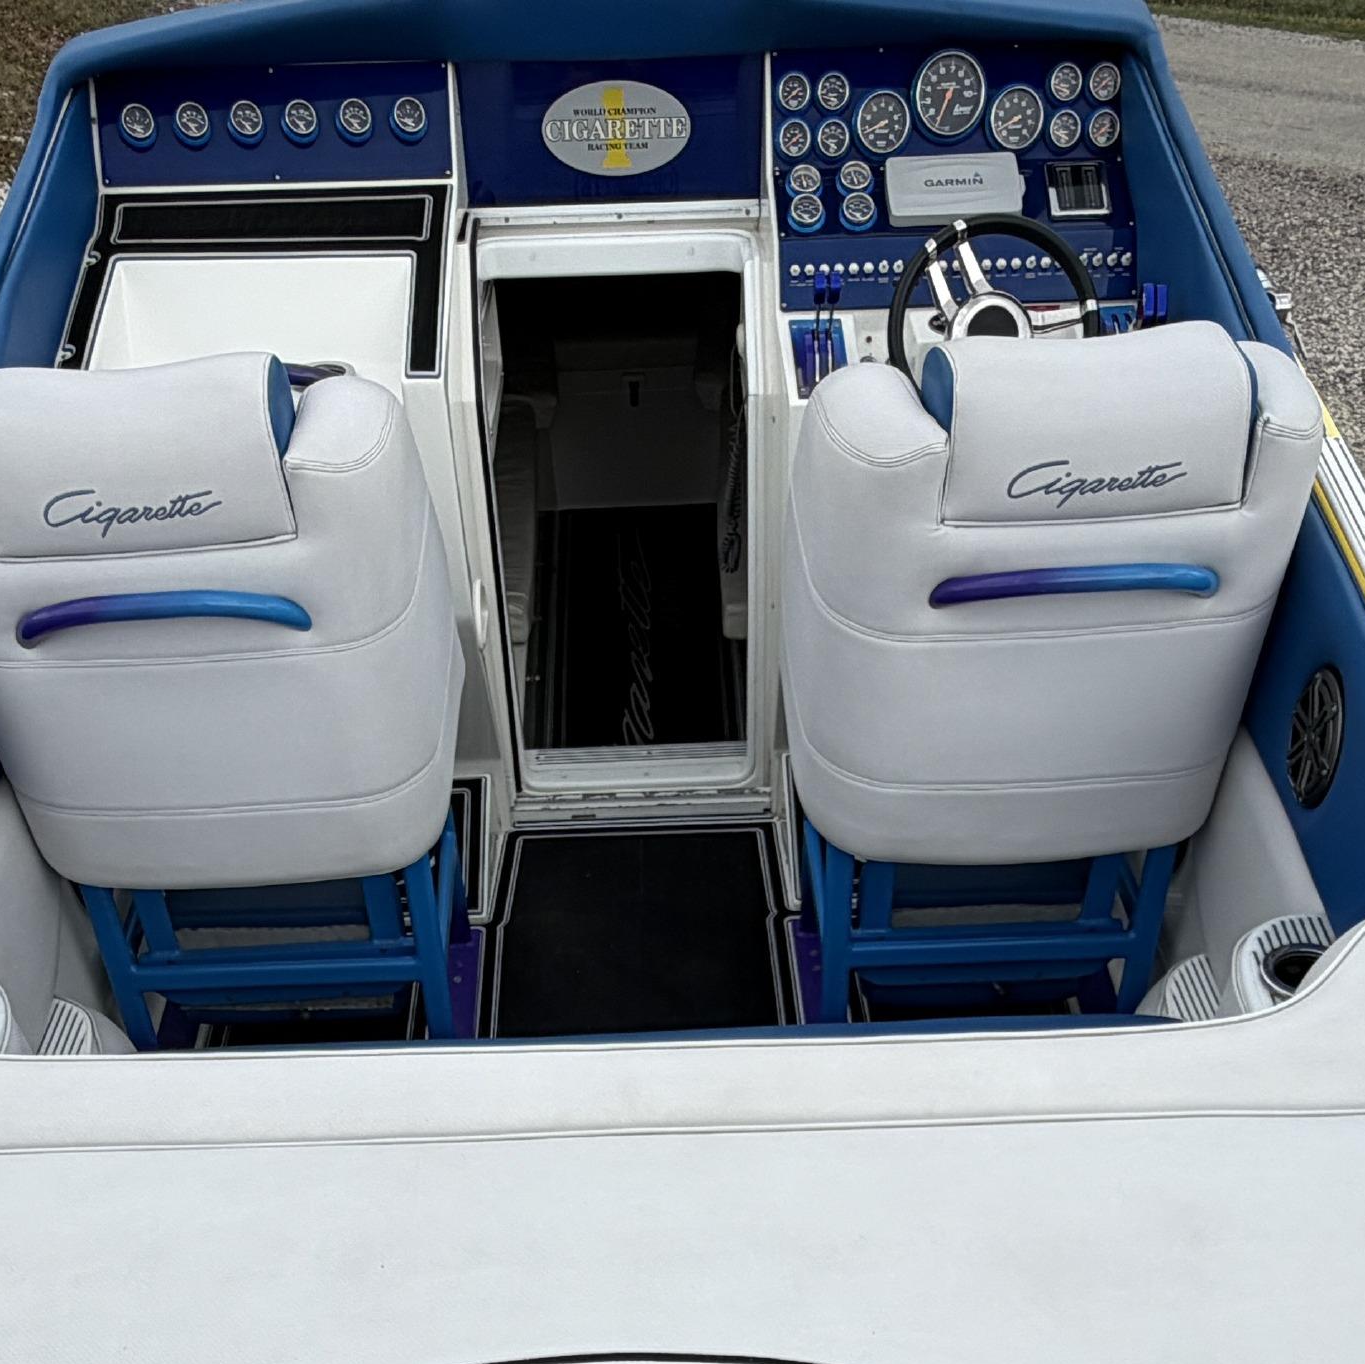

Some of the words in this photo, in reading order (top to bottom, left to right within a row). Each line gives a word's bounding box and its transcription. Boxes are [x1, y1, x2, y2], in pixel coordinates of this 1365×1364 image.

[572, 108, 606, 117] WORLD
[607, 106, 657, 116] CHAMPION
[544, 116, 688, 143] CIGARETTE
[587, 142, 621, 152] RACING
[624, 141, 649, 150] TEAM
[923, 177, 984, 188] GARMIN
[1007, 459, 1188, 509] Cigarette
[43, 489, 223, 538] Cigarette
